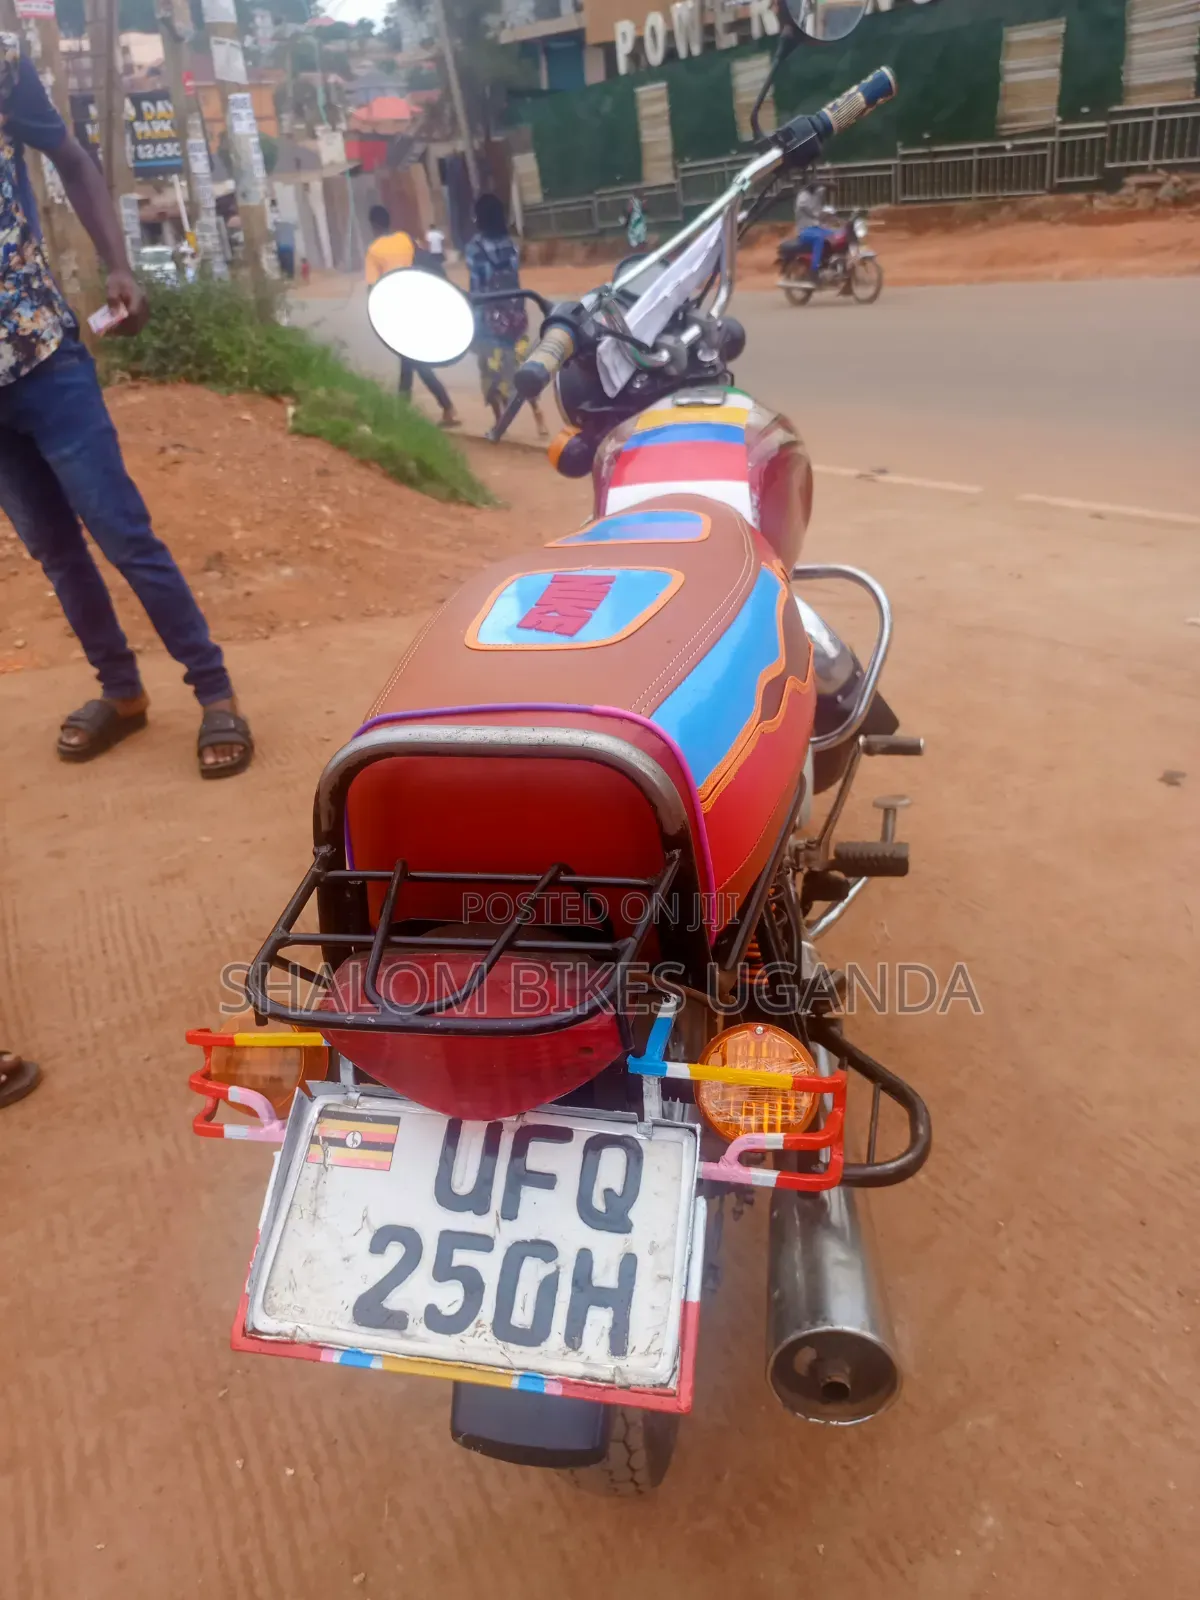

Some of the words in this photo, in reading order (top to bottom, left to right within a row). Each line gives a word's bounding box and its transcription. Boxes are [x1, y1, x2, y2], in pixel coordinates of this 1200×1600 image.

[614, 0, 780, 76] POWER
[434, 1118, 644, 1234] UFQ
[352, 1223, 638, 1358] 250H
